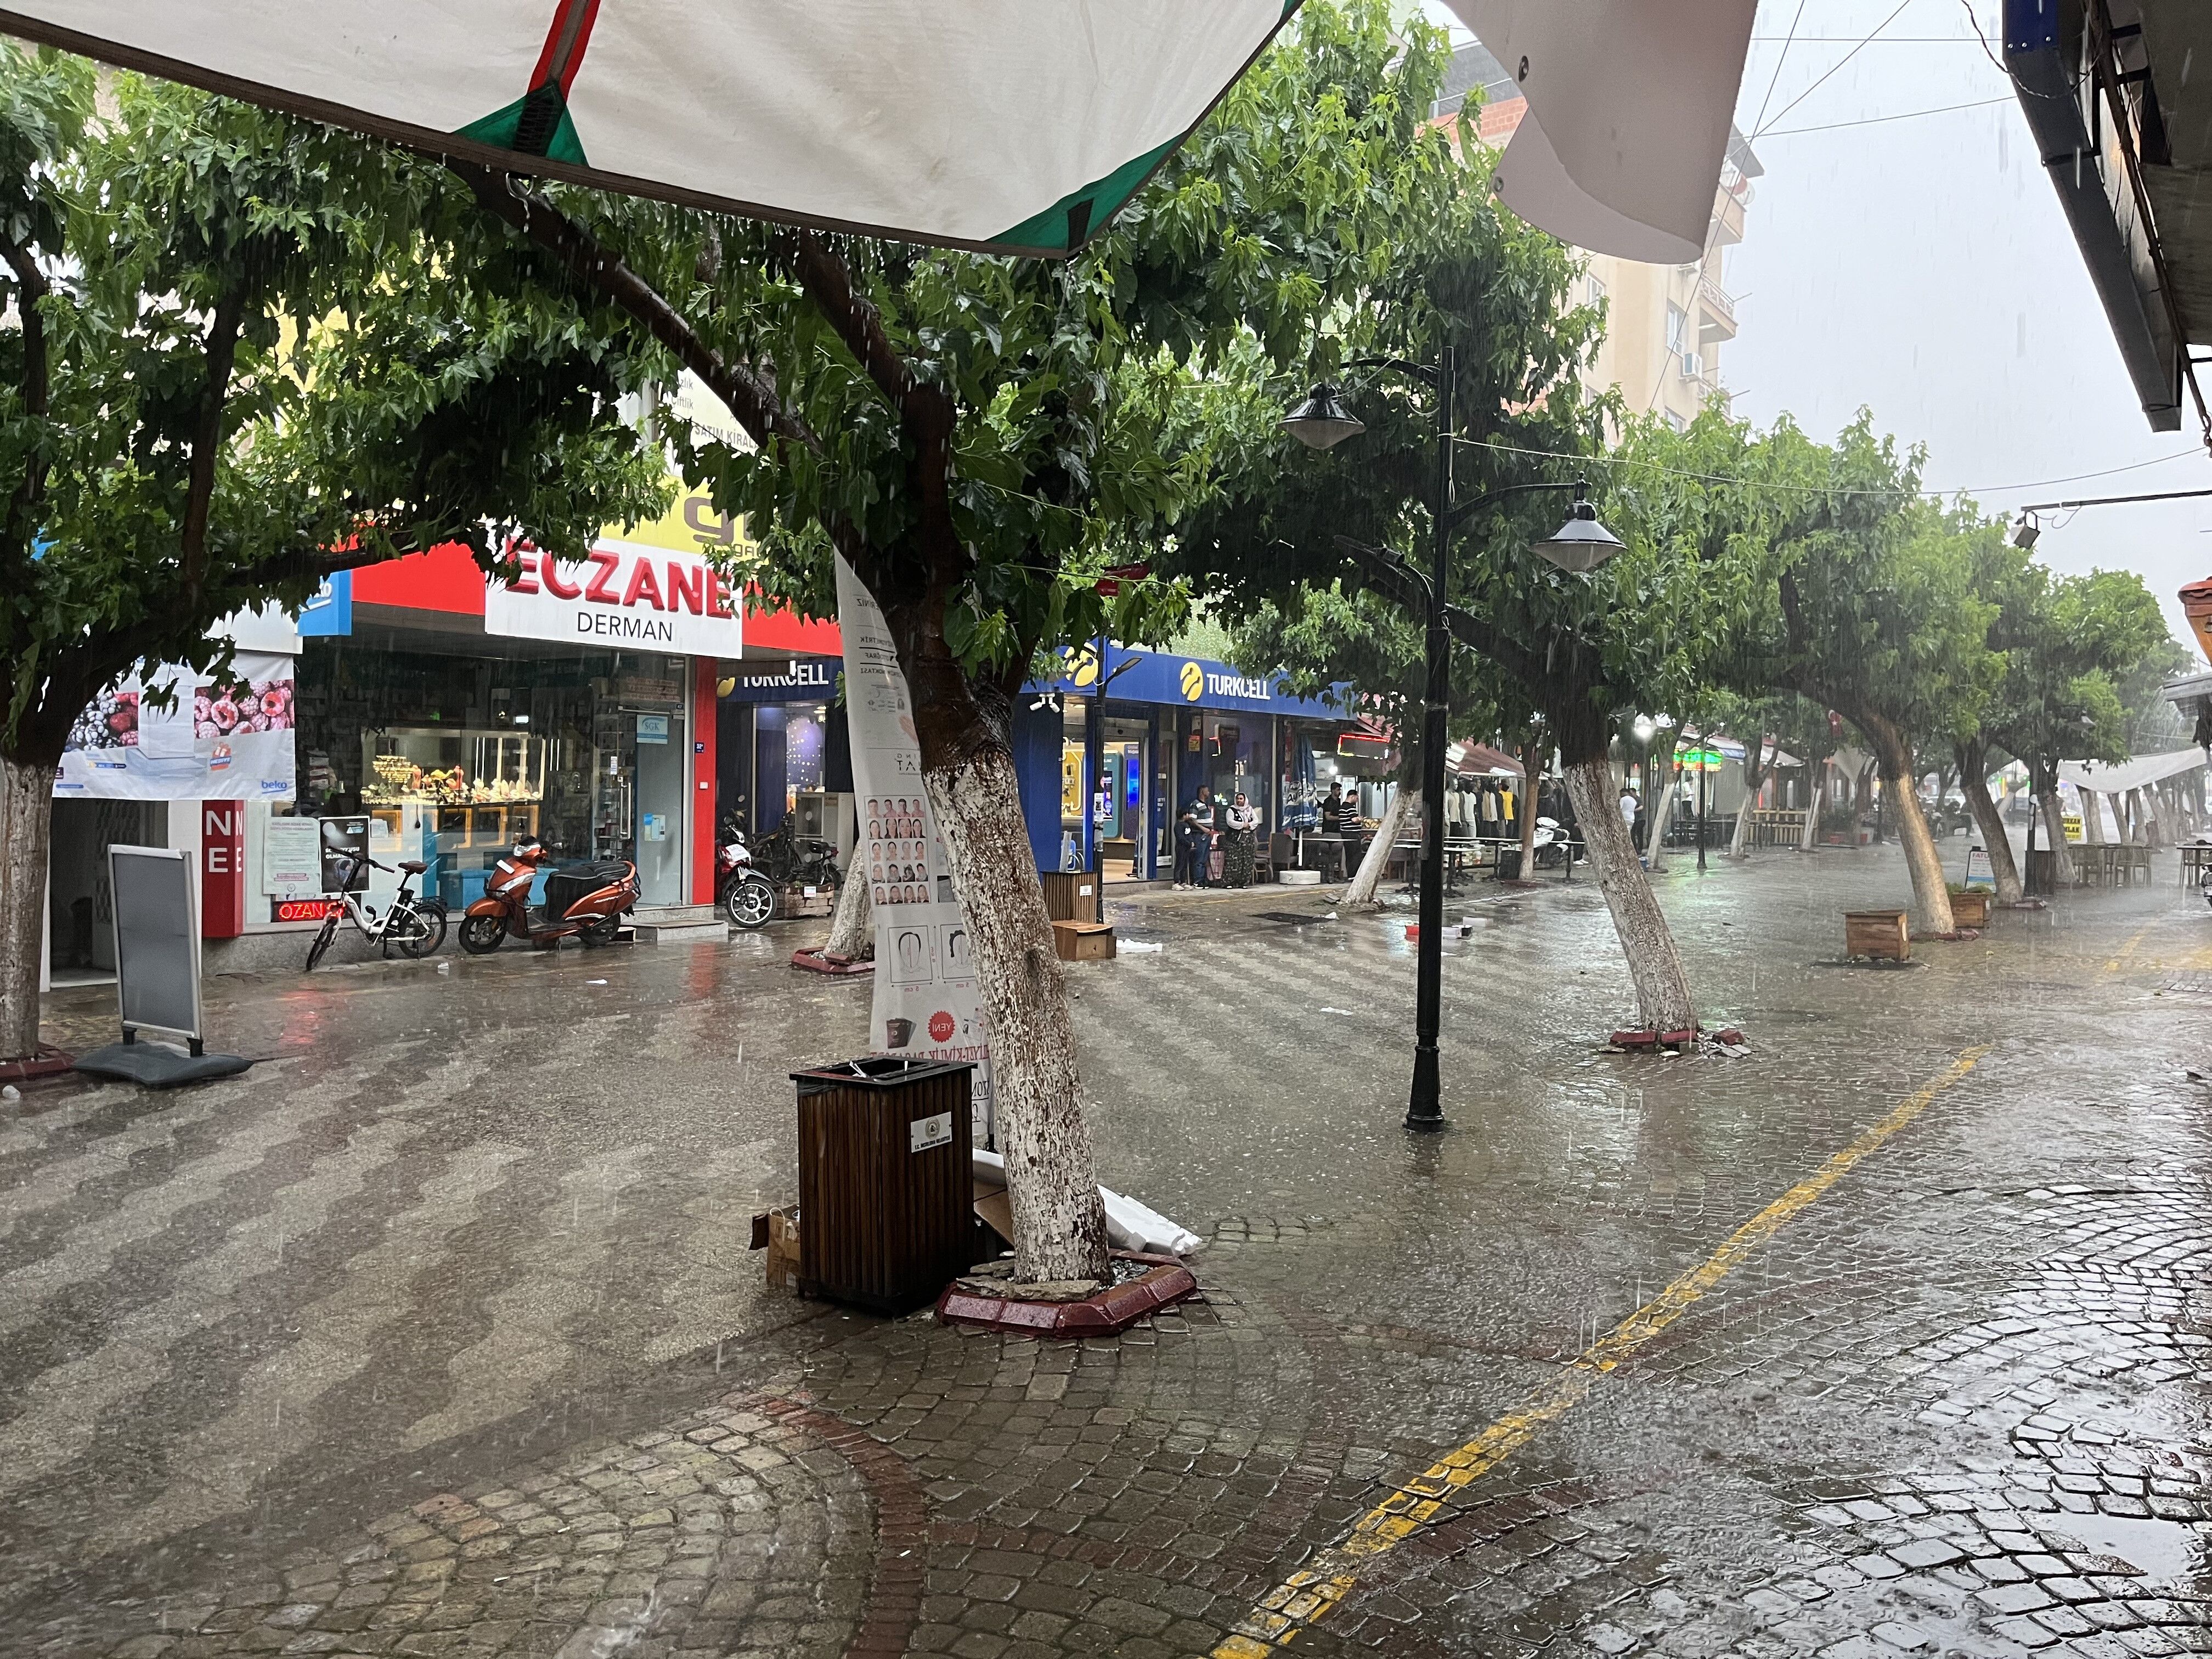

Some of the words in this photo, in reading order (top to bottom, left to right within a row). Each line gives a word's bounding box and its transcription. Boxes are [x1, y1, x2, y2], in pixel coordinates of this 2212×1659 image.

[695, 425, 724, 441] SATIM
[505, 536, 732, 619] ECZANE
[578, 612, 673, 642] DERMAN
[1206, 668, 1271, 700] TURKCELL
[261, 780, 287, 789] beko
[279, 902, 324, 919] OZAN
